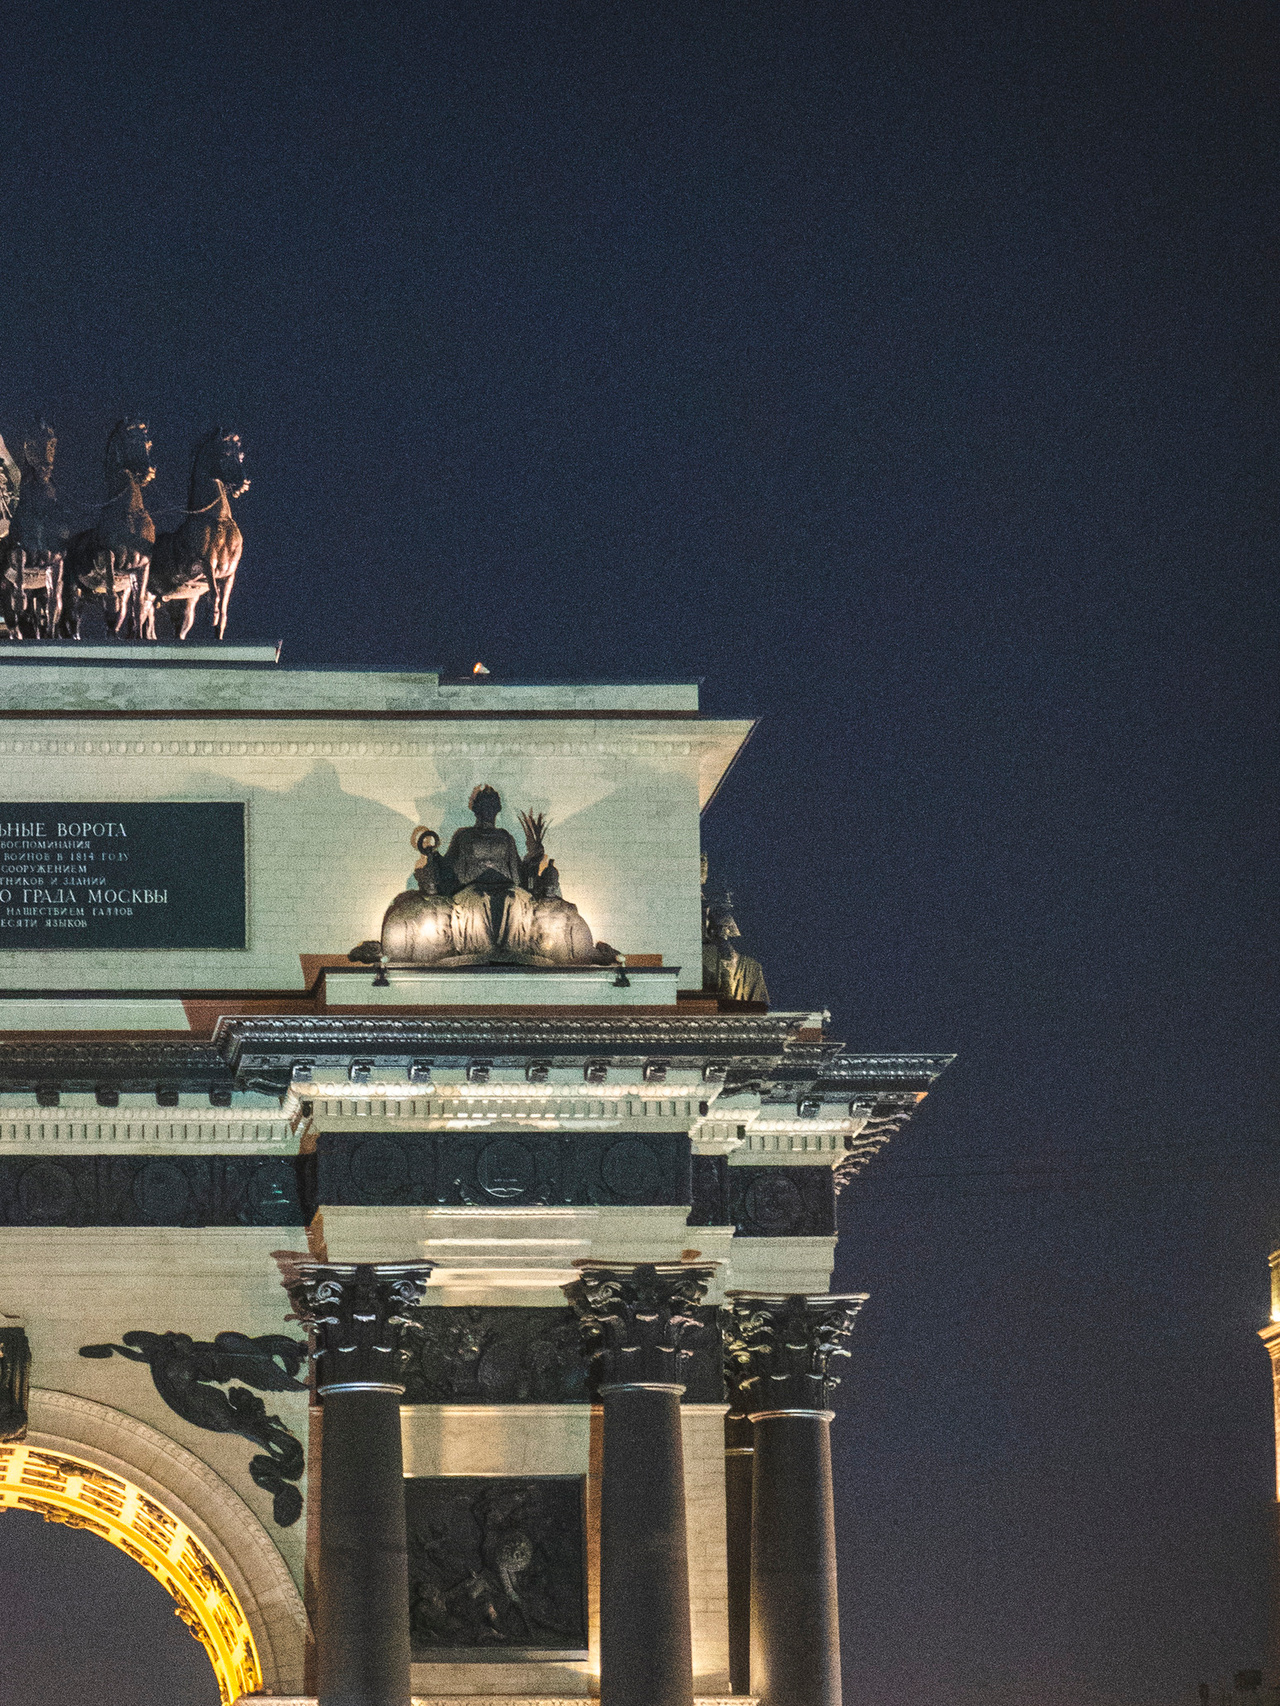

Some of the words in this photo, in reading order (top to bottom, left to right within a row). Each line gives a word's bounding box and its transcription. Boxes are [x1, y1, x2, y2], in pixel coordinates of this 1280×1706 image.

[58, 822, 127, 836] ВОРОТА
[0, 841, 91, 850] ВОСПОМИНАНИЯ
[57, 852, 64, 861] В
[70, 852, 94, 861] 1814
[1, 864, 87, 874] СООРУЖЕНИЕМ
[50, 877, 58, 886] И
[23, 889, 76, 904] ГРАДА
[88, 889, 168, 904] МОСКВЫ
[6, 907, 84, 916] НАШЕСТВИЕМ
[44, 919, 88, 928] ЯЗЫКОВ
